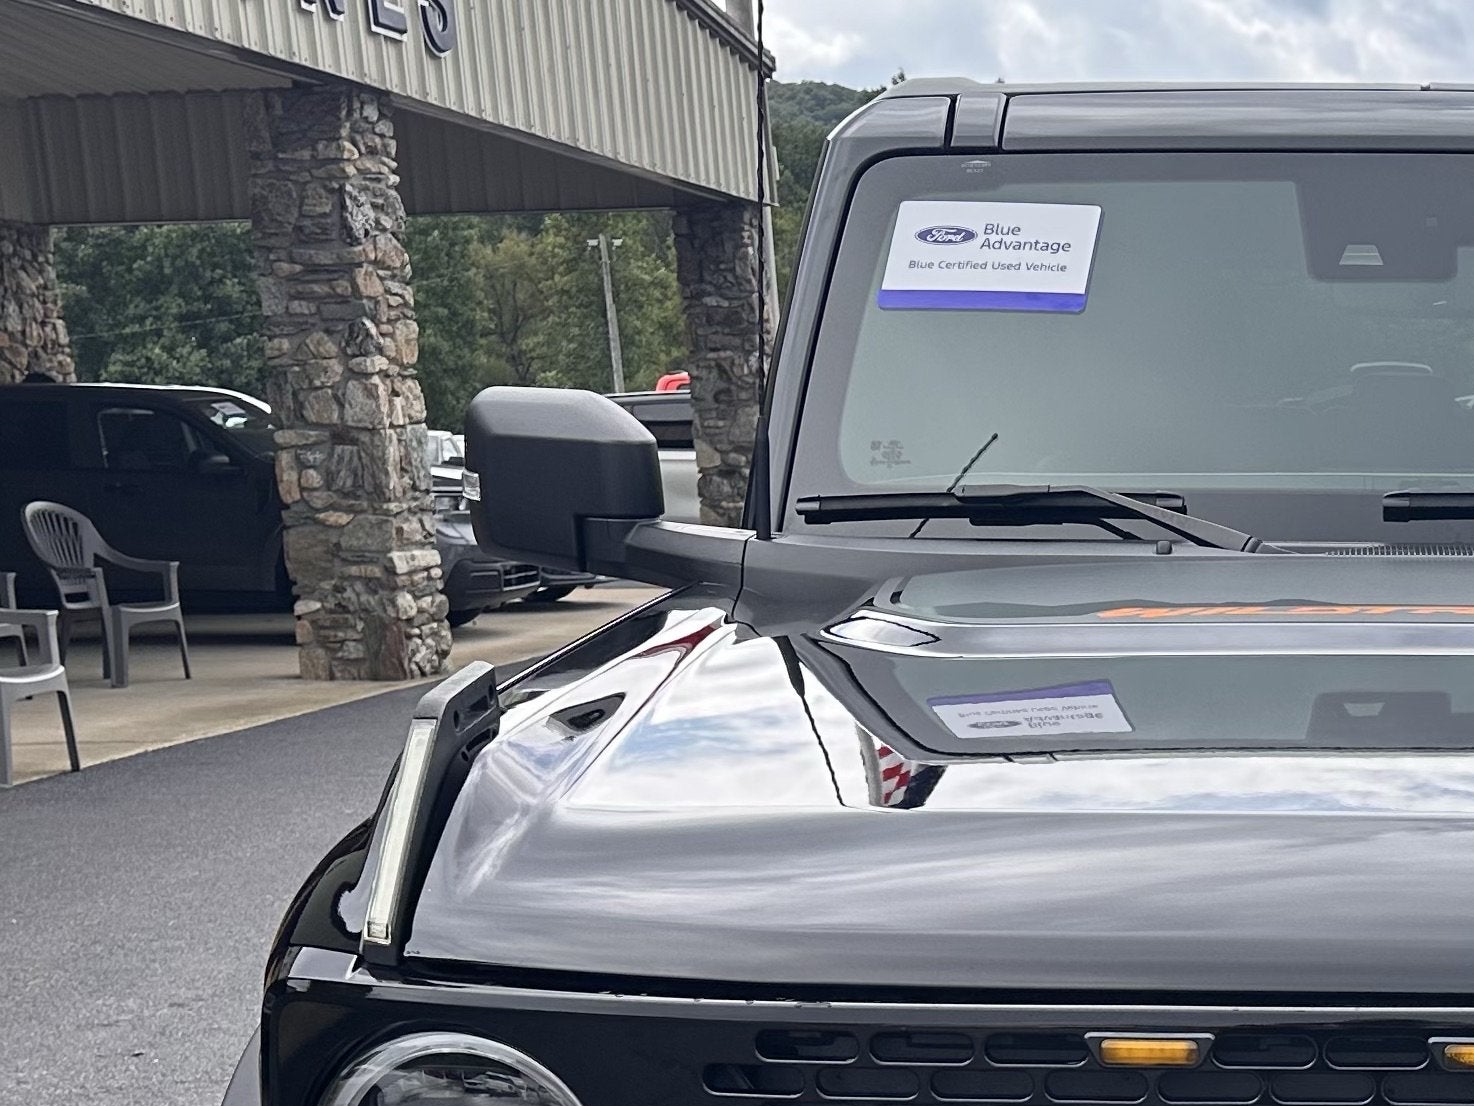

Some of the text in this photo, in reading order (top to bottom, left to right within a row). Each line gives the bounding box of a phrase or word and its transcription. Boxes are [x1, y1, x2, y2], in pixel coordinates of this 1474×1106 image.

[926, 228, 966, 243] Ford
[984, 223, 1021, 236] Blue
[980, 238, 1072, 254] Advantage
[908, 260, 1067, 272] Blue Certified Used Vehicle
